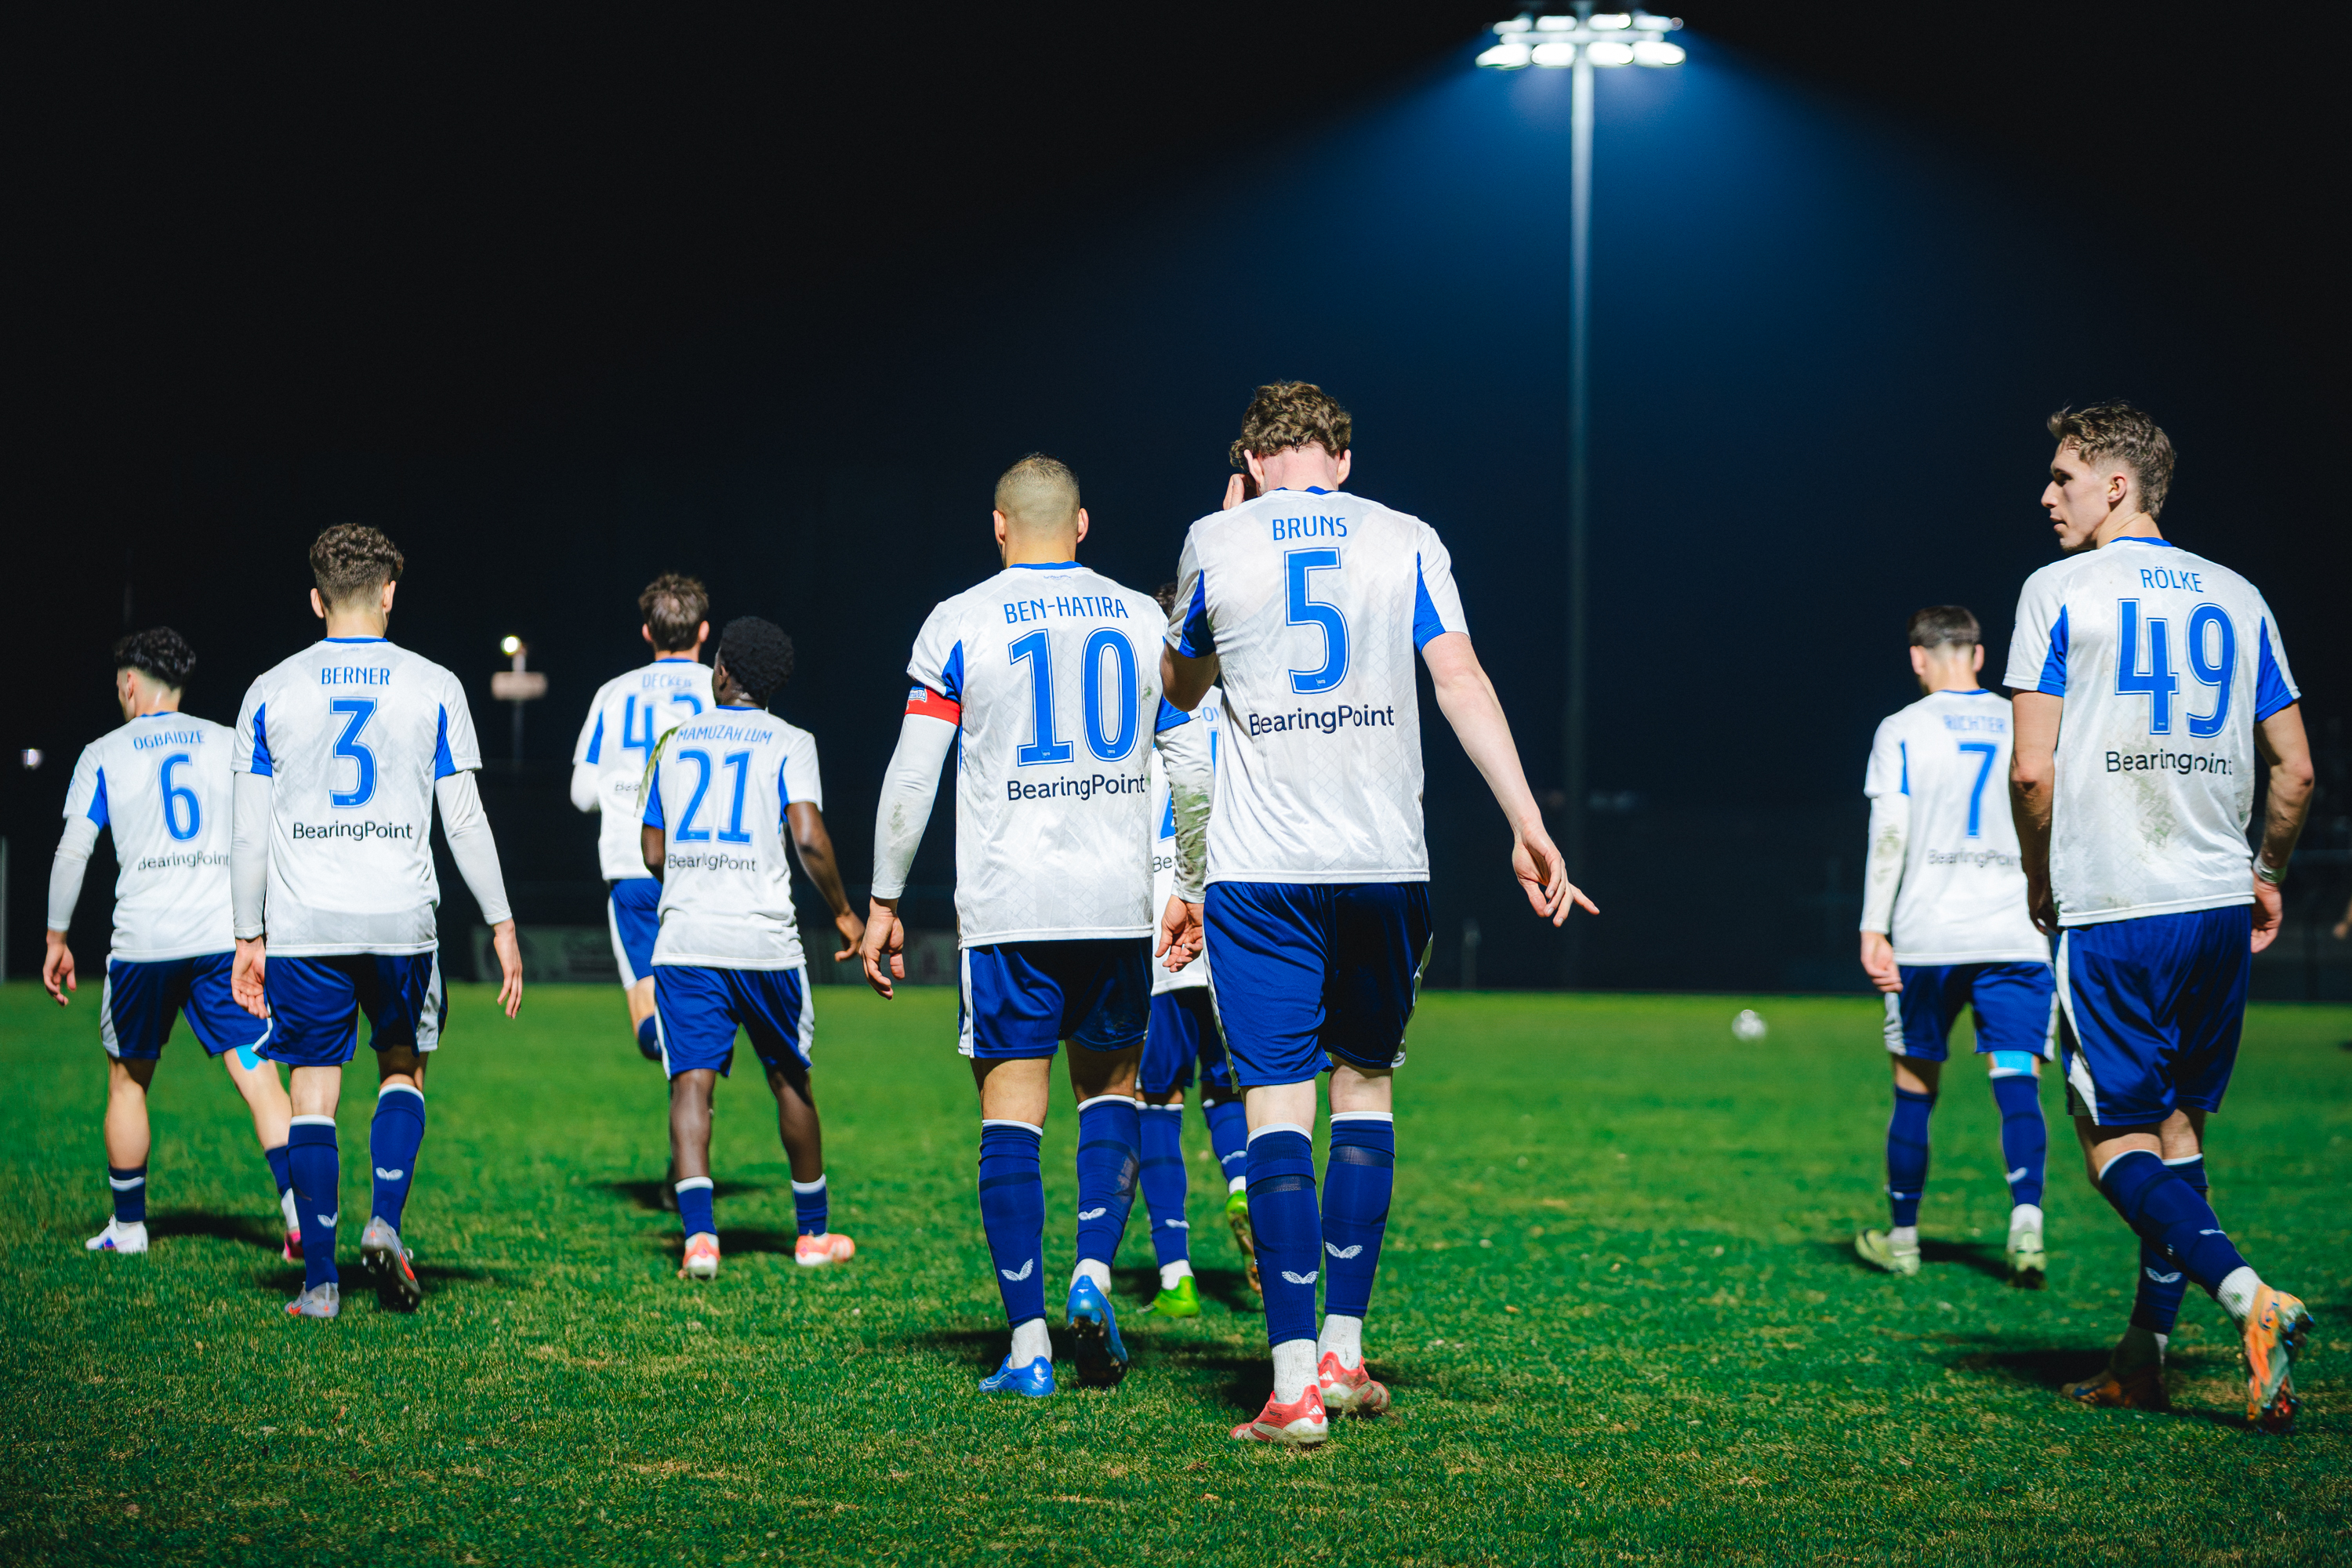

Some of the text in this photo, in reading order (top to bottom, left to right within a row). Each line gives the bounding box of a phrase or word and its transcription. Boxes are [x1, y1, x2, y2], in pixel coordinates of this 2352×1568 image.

[1272, 516, 1348, 541] BRUNS
[2140, 566, 2204, 593] RÖLKE
[1004, 597, 1129, 624] BEN-HATIRA
[1283, 546, 1351, 695] 5
[321, 667, 390, 685] BERNER
[2114, 598, 2239, 739] 49
[1007, 627, 1141, 768] 10
[676, 724, 773, 745] MAMUZAH LUM
[1248, 704, 1395, 736] BearingPoint
[133, 730, 205, 750] OGBAIDZE
[328, 696, 378, 809] 3
[158, 750, 203, 842] 6
[673, 746, 754, 846] 21
[1007, 773, 1145, 801] BearingPoint
[1957, 739, 2000, 839] 7
[293, 819, 413, 841] BearingPoint
